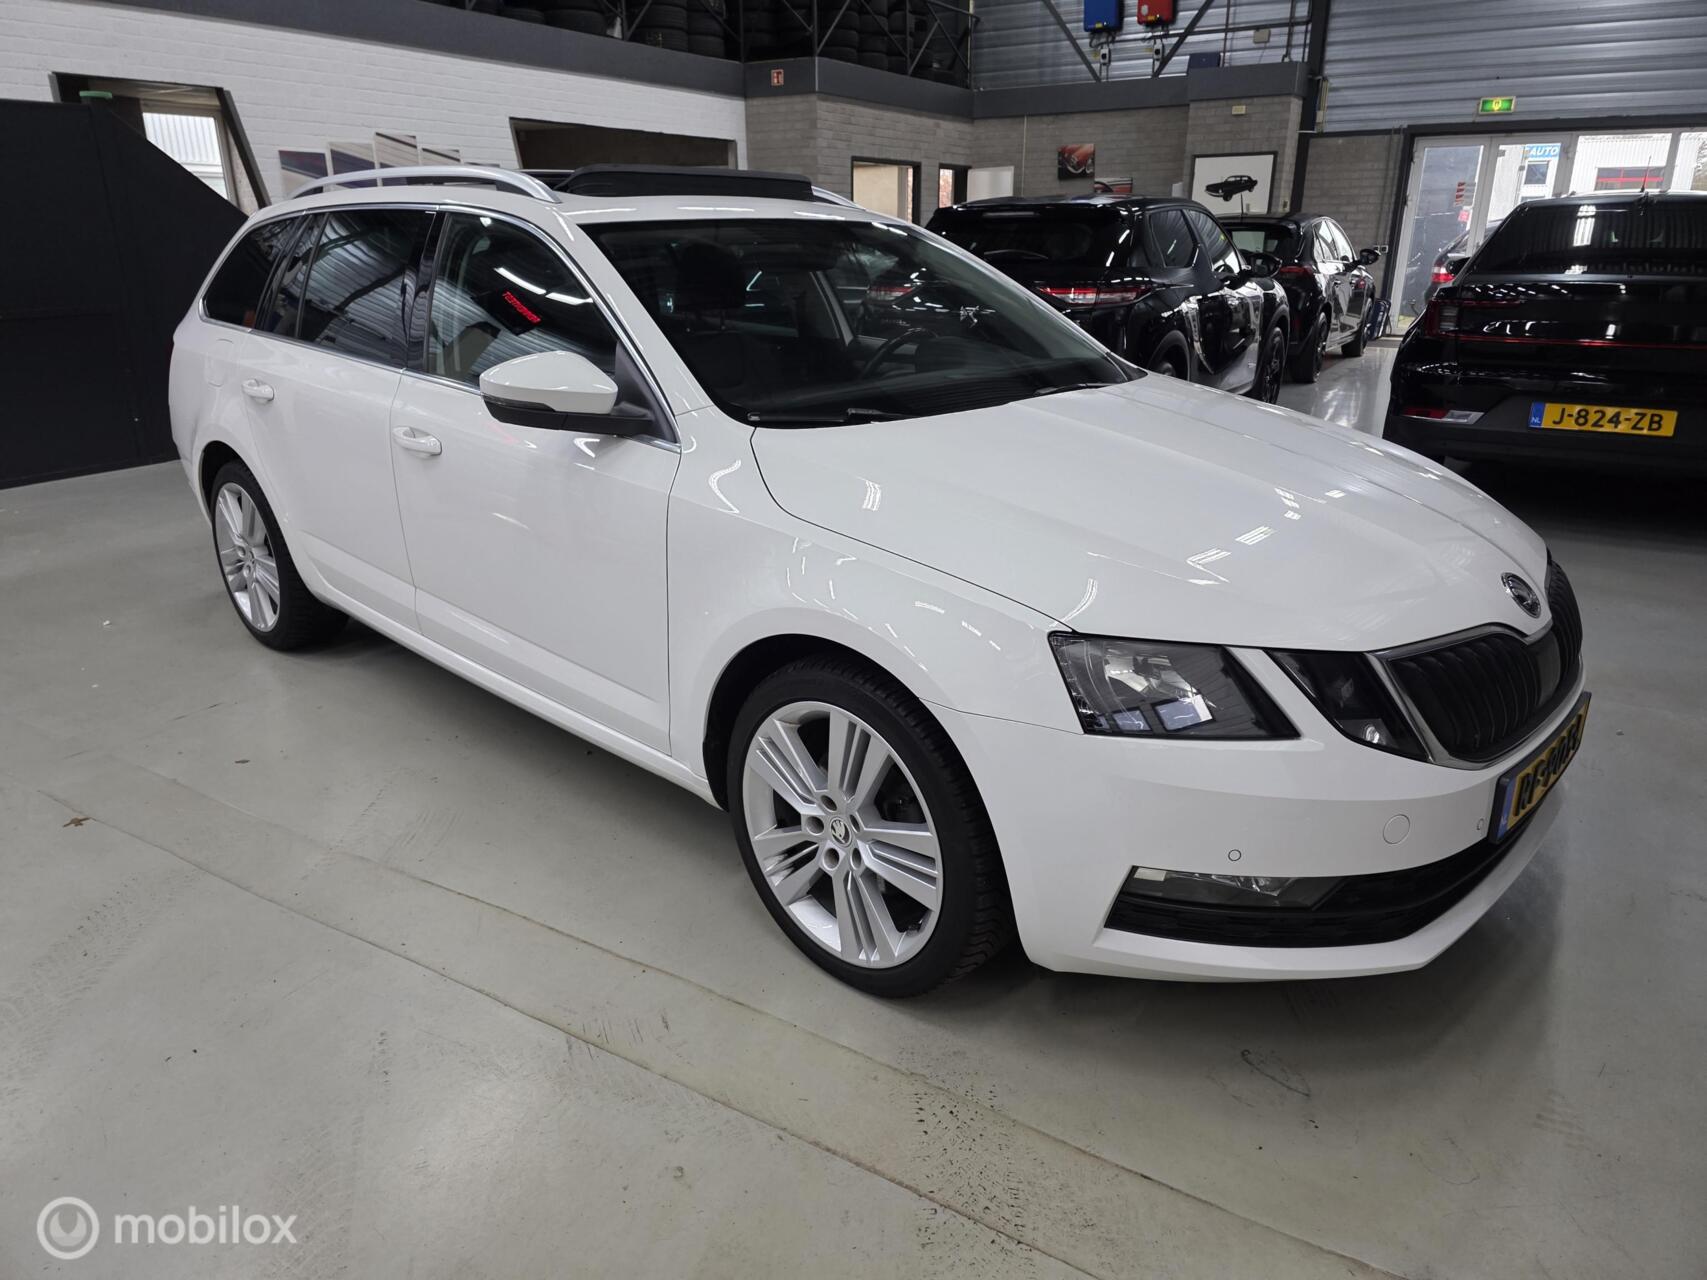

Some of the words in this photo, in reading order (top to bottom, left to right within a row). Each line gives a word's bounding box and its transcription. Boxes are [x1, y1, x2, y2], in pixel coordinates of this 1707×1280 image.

[1529, 146, 1559, 156] AUTO
[1531, 416, 1541, 424] NL
[1552, 407, 1664, 432] J-824-ZB
